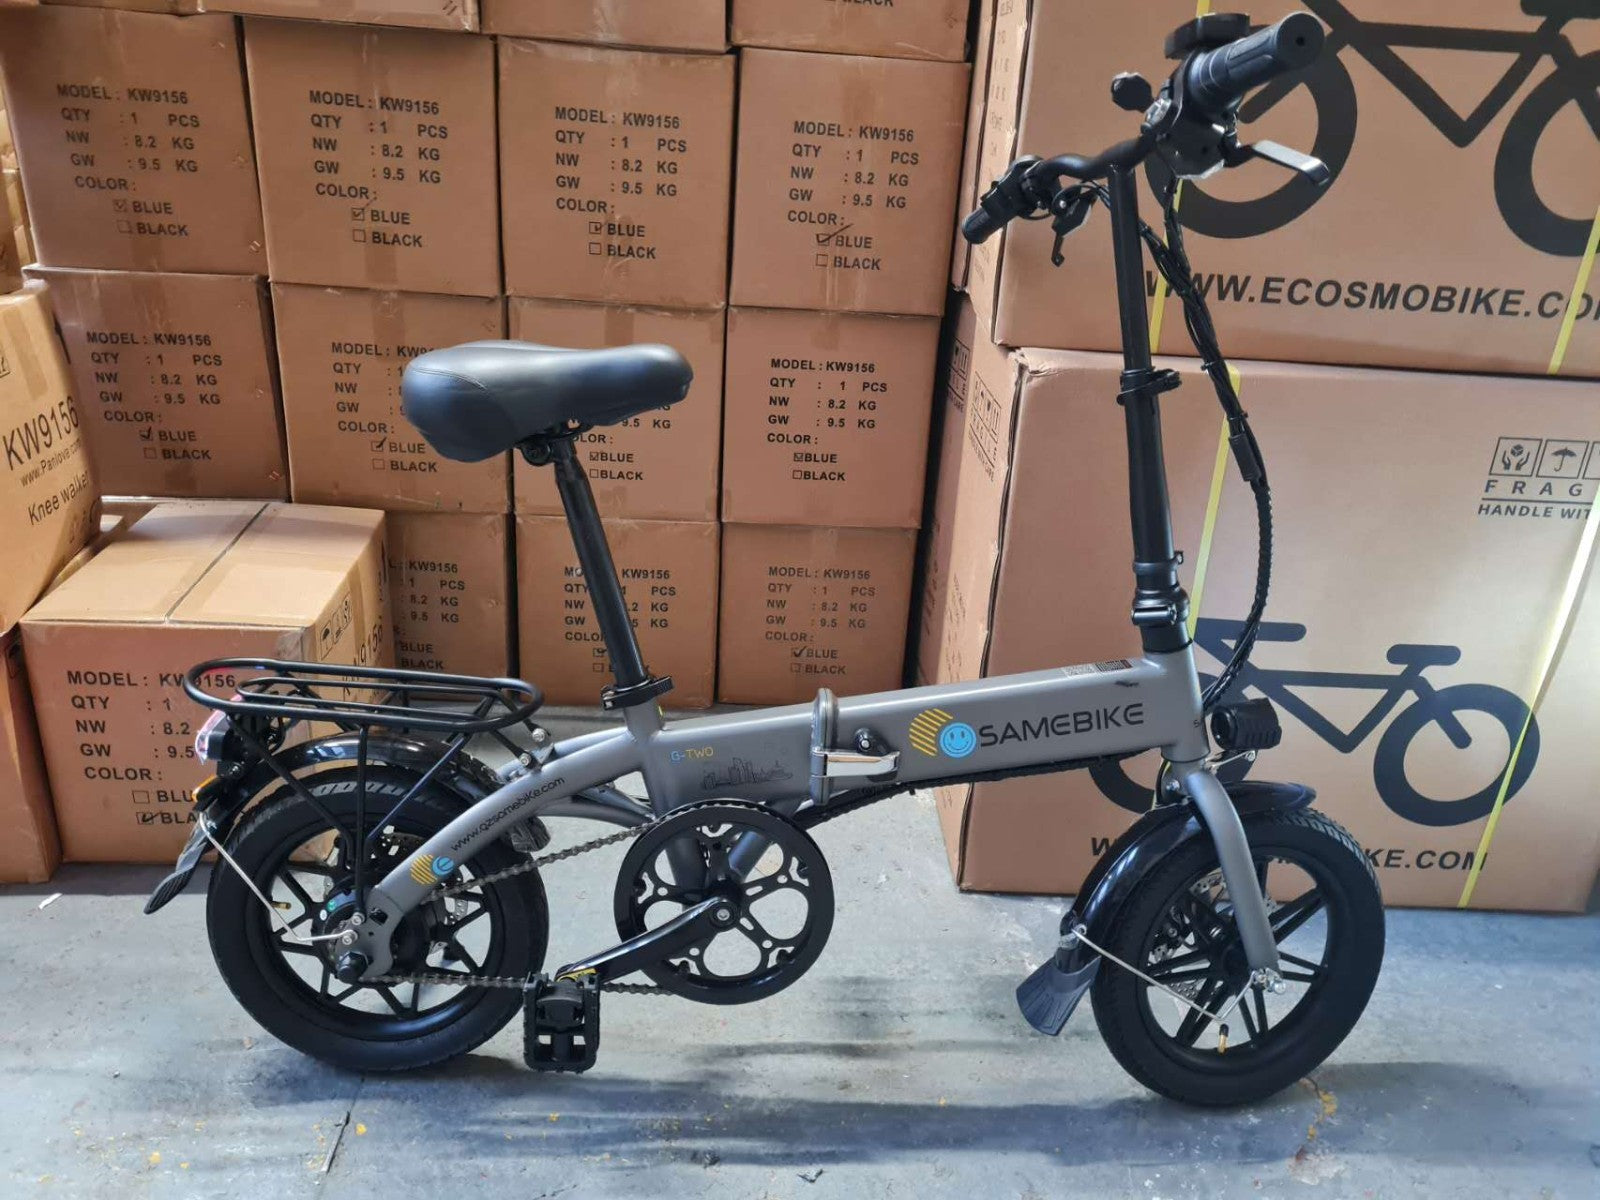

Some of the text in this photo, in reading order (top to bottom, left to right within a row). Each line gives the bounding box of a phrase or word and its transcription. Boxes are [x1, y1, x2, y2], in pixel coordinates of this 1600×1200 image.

[127, 88, 188, 104] KW9156
[380, 97, 439, 115] KW9156
[61, 108, 90, 122] QTY
[169, 114, 200, 127] PCS
[622, 113, 680, 128] KW9156
[311, 114, 341, 128] QTY
[418, 124, 448, 139] PCS
[65, 130, 90, 144] NW
[172, 137, 194, 150] KG
[859, 126, 914, 142] KW9156
[555, 130, 585, 144] QTY
[657, 138, 686, 152] PCS
[313, 137, 337, 151] NW
[419, 147, 440, 161] KG
[792, 144, 821, 157] QTY
[891, 151, 919, 165] PCS
[71, 154, 95, 167] GW
[176, 160, 198, 172] KG
[556, 153, 579, 166] NW
[657, 161, 678, 174] KG
[314, 160, 339, 174] GW
[419, 170, 441, 183] KG
[791, 166, 814, 179] NW
[889, 173, 908, 187] KG
[556, 176, 580, 189] GW
[656, 184, 677, 196] KG
[789, 188, 813, 201] GW
[886, 196, 906, 208] KG
[132, 201, 173, 214] BLUE
[371, 210, 410, 224] BLUE
[137, 223, 188, 236] BLACK
[607, 223, 645, 237] BLUE
[372, 232, 423, 247] BLACK
[835, 235, 872, 248] BLUE
[607, 244, 656, 259] BLACK
[834, 256, 881, 270] BLACK
[154, 334, 212, 346] KW9156
[91, 352, 119, 364] QTY
[193, 355, 222, 366] PCS
[333, 363, 361, 374] QTY
[826, 361, 875, 373] KW9156
[95, 372, 118, 383] NW
[196, 375, 217, 385] KG
[334, 382, 357, 394] NW
[770, 378, 795, 388] QTY
[862, 382, 888, 393] PCS
[100, 392, 122, 402] GW
[200, 394, 220, 405] KG
[769, 396, 790, 406] NW
[859, 401, 876, 410] KG
[336, 402, 359, 412] GW
[653, 419, 671, 429] KG
[768, 415, 789, 425] GW
[858, 419, 875, 429] KG
[3, 396, 79, 471] KW9156
[159, 431, 197, 442] BLUE
[389, 442, 426, 454] BLUE
[163, 450, 211, 460] BLACK
[601, 453, 634, 462] BLUE
[805, 453, 838, 463] BLUE
[390, 460, 438, 472] BLACK
[601, 470, 643, 480] BLACK
[804, 471, 845, 481] BLACK
[28, 494, 60, 525] Knee
[61, 471, 89, 504] walker
[1478, 504, 1553, 518] HANDLE
[409, 562, 458, 573] KW9156
[622, 568, 670, 579] KW9156
[823, 569, 870, 579] KW9156
[440, 580, 465, 590] PCS
[651, 587, 676, 596] PCS
[768, 583, 792, 593] QTY
[851, 587, 875, 597] PCS
[441, 597, 458, 607] KG
[565, 600, 584, 609] NW
[651, 603, 668, 612] KG
[767, 599, 786, 609] NW
[850, 603, 867, 612] KG
[442, 613, 459, 623] KG
[565, 616, 668, 628] GW KG
[766, 616, 786, 625] GW
[849, 619, 866, 628] KG
[402, 642, 433, 653] BLUE
[807, 649, 838, 658] BLUE
[402, 659, 444, 670] BLACK
[805, 664, 847, 675] BLACK
[71, 695, 110, 709] QTY
[76, 720, 106, 733] NW
[980, 702, 1144, 747] SAMEBIKE
[80, 744, 111, 757] GW
